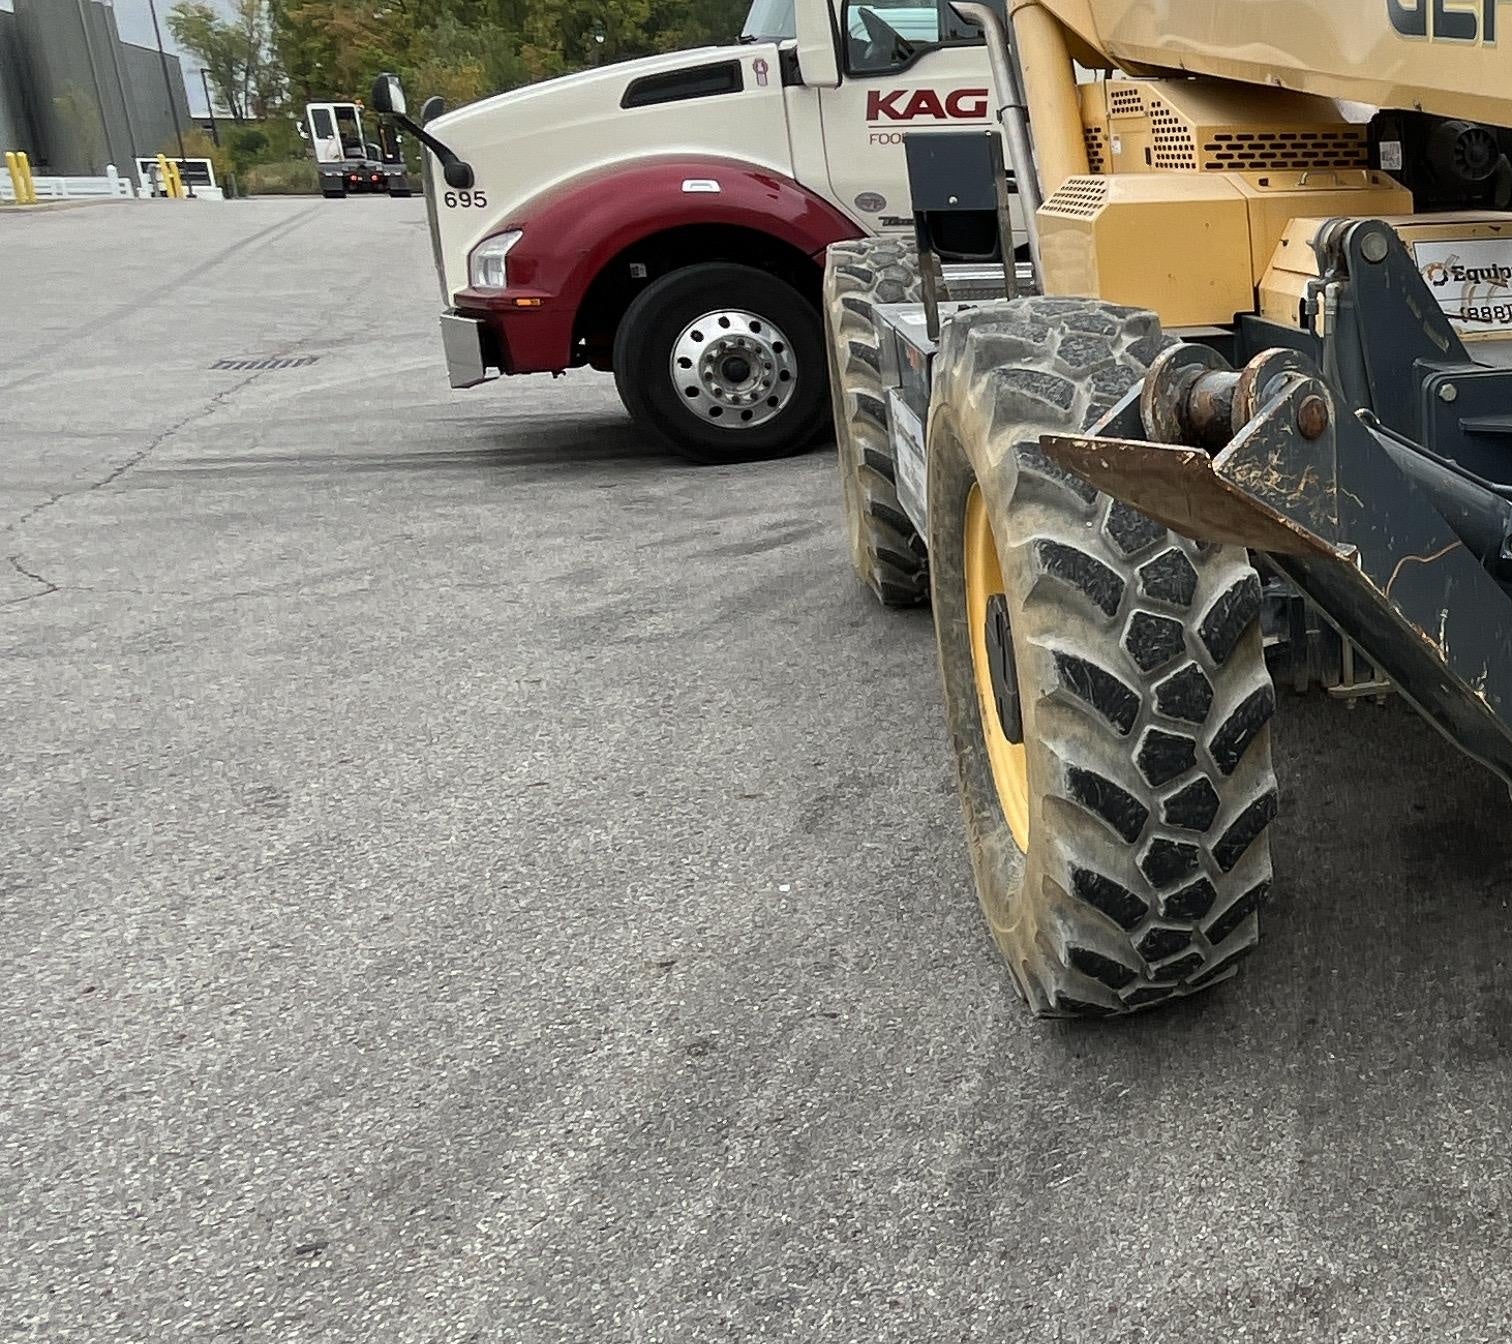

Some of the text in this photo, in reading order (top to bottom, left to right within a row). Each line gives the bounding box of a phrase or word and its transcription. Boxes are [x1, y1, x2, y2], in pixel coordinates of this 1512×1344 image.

[866, 88, 989, 121] KAG
[869, 133, 908, 145] FOO
[444, 190, 488, 209] 695
